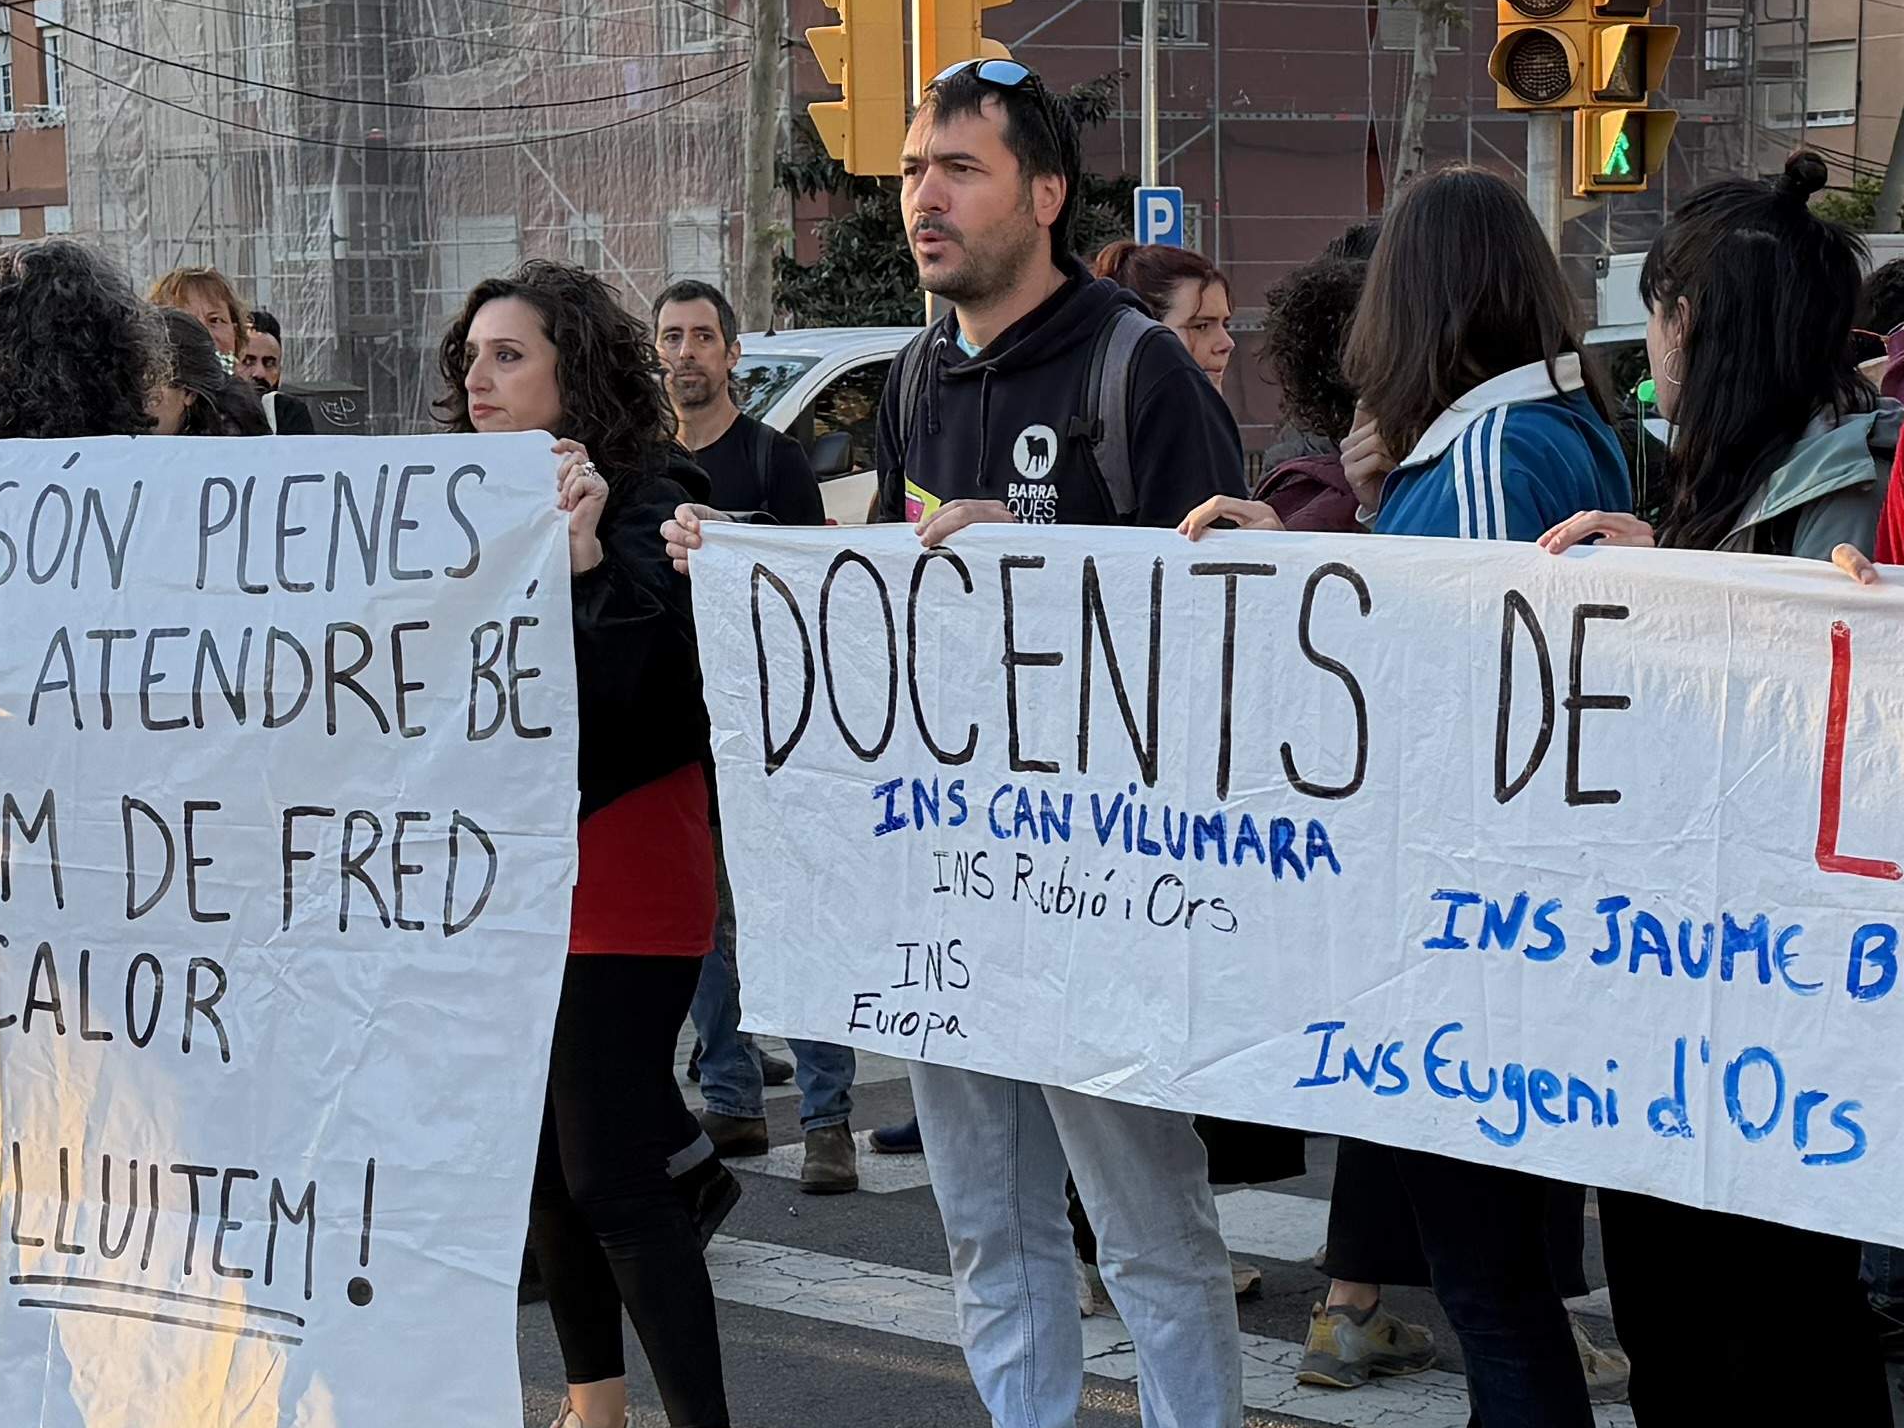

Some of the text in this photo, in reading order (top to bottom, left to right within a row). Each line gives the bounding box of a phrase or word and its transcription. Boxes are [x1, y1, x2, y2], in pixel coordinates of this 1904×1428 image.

[1147, 197, 1175, 245] P
[195, 463, 485, 595] PLENES
[1007, 483, 1059, 500] BARRA
[1007, 499, 1056, 519] QUES
[28, 620, 431, 740] ATENDRE
[467, 579, 553, 742] BÉ
[749, 547, 1372, 801] DOCENTS
[1494, 588, 1632, 806] DE
[872, 773, 968, 837] INS
[988, 783, 1073, 845] CAN
[121, 795, 231, 923] DE
[281, 805, 498, 939] FRED
[932, 850, 995, 901] INS
[1012, 852, 1115, 920] Rubió
[1147, 873, 1239, 934] Ors
[891, 939, 970, 992] INS
[1422, 888, 1567, 962] INS
[1589, 895, 1824, 996] JAUME
[847, 993, 967, 1058] Europa
[1422, 1021, 1619, 1148] Eugeni
[1647, 1035, 1869, 1167] d'Ors
[10, 1141, 376, 1307] LLUITEM!
